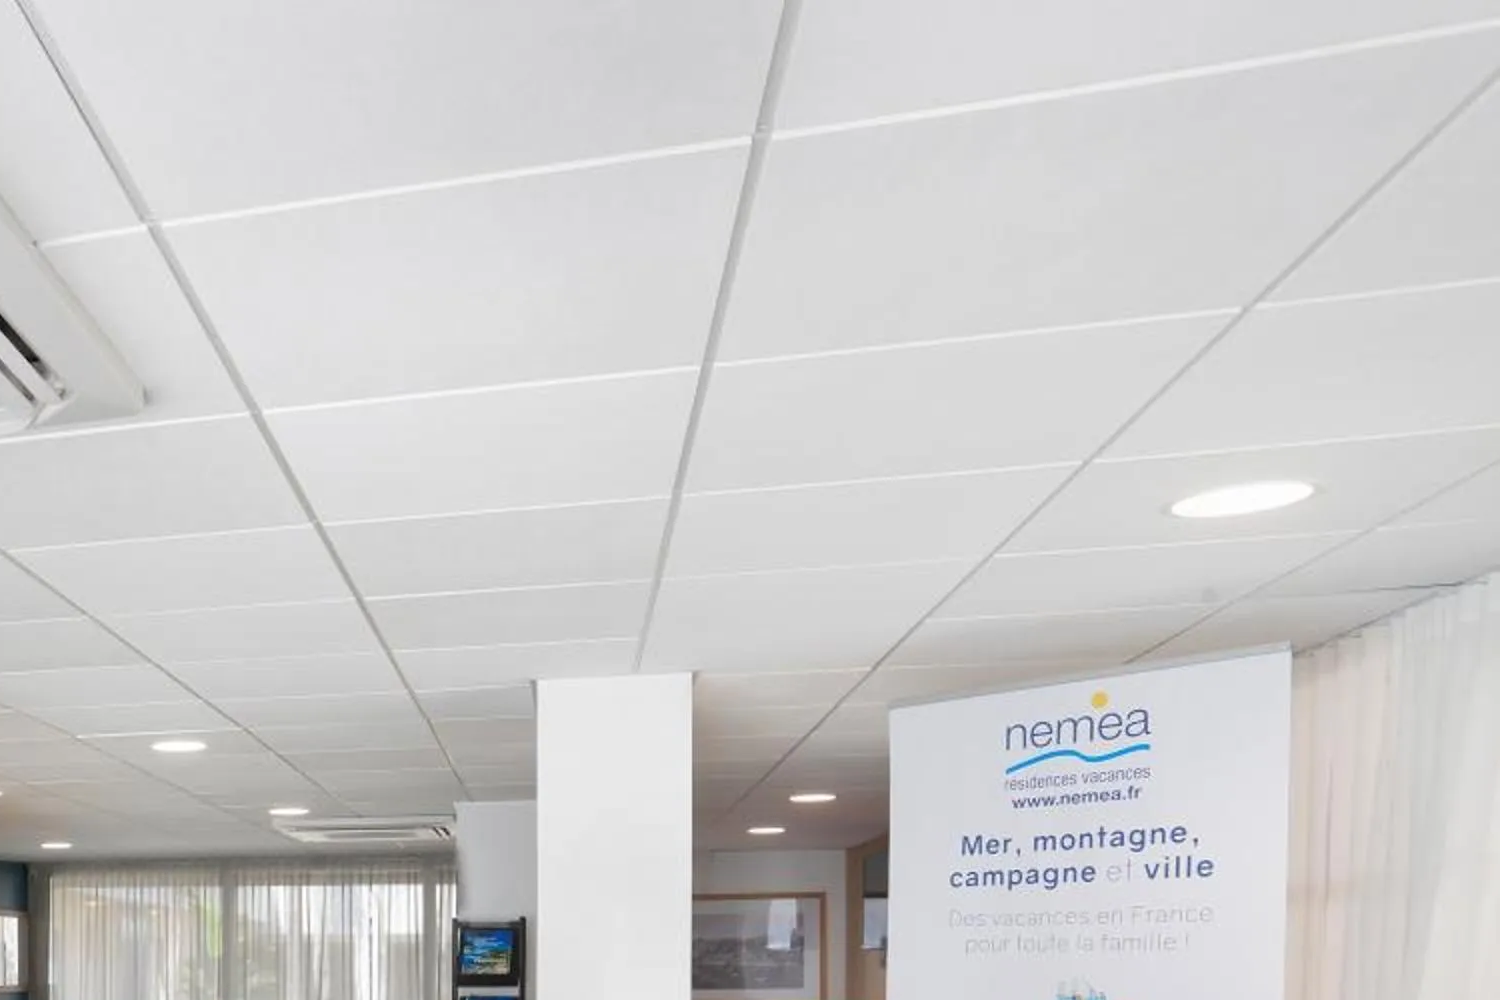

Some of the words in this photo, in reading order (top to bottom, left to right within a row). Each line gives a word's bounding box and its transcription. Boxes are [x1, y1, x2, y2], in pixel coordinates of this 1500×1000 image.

[1005, 708, 1151, 751] nemea
[1081, 766, 1151, 785] vacances
[1012, 785, 1142, 809] www.nemea.fr
[960, 835, 1021, 857] Mer,
[1033, 825, 1202, 853] montagne,
[950, 864, 1097, 891] campagne
[1105, 858, 1133, 882] et
[1144, 856, 1215, 880] ville
[949, 909, 988, 929] Des
[991, 909, 1091, 928] vacances
[1097, 908, 1124, 926] en
[1129, 904, 1216, 925] France
[964, 938, 1010, 957] pour
[1077, 934, 1095, 951] la
[1101, 932, 1179, 953] famille
